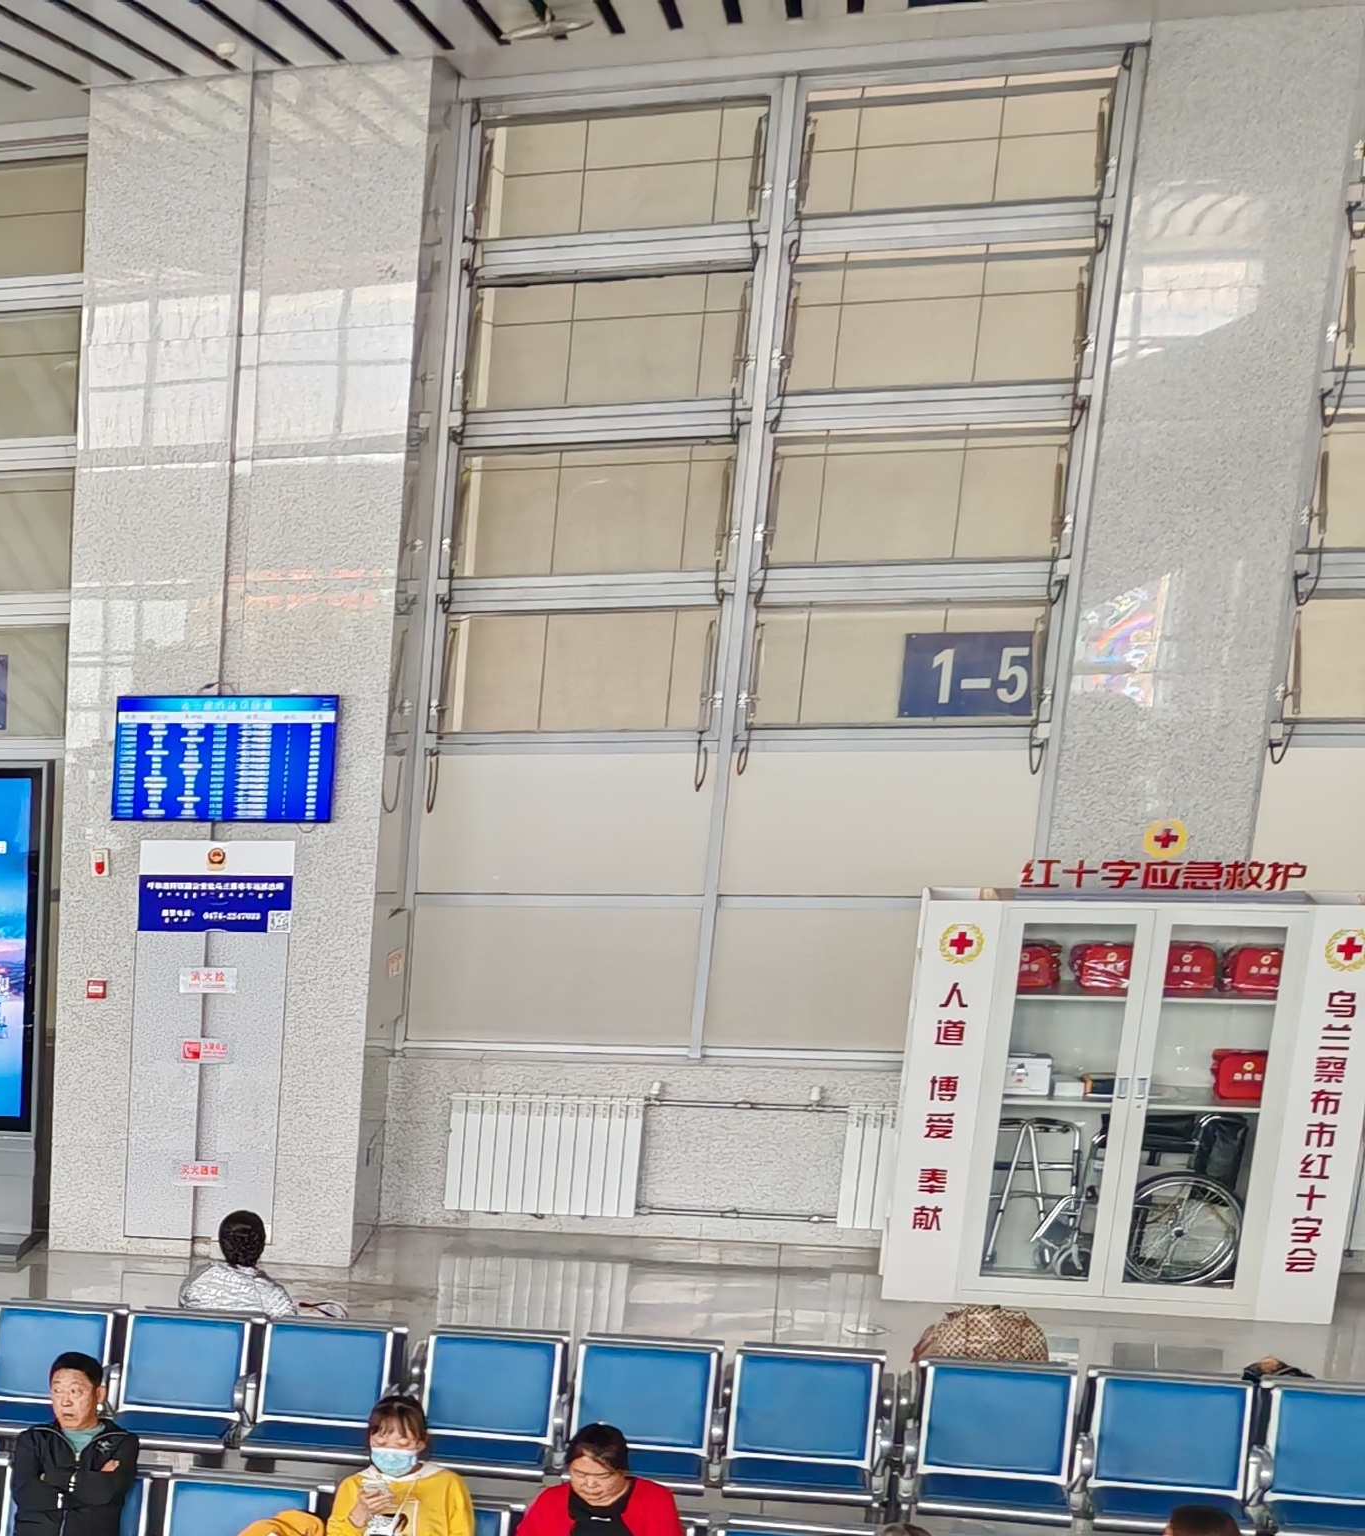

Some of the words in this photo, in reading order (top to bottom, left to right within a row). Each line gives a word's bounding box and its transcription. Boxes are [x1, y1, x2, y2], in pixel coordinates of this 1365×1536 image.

[932, 647, 1030, 704] 1-5
[1019, 859, 1308, 891] 红十字应急救护
[935, 982, 968, 1046] 人道
[924, 1075, 959, 1139] 博爱
[1285, 990, 1357, 1273] 乌兰察布市红十字会
[912, 1168, 948, 1231] 奉献
